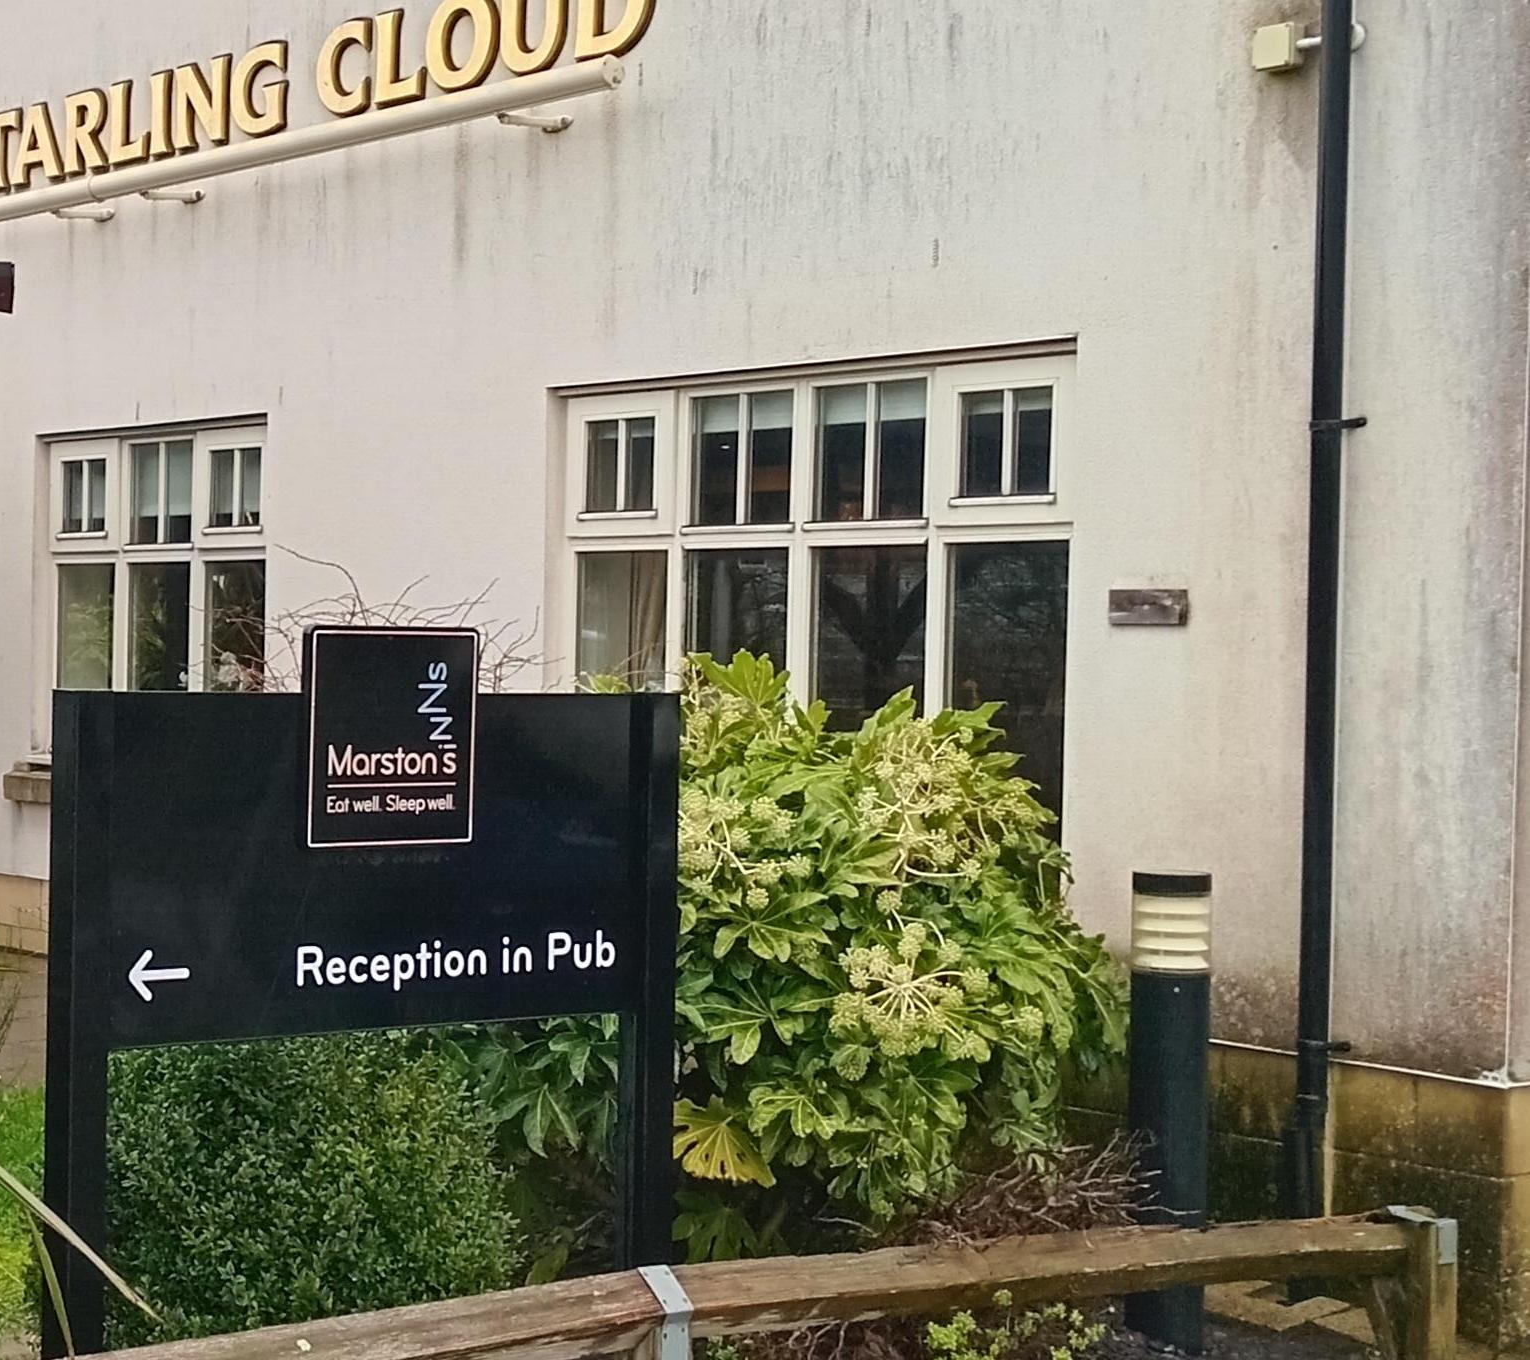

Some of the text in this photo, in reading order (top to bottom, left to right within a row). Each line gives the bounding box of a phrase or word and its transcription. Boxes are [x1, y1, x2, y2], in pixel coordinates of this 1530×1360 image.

[326, 796, 350, 813] Eat
[385, 794, 426, 815] Sleep
[296, 929, 616, 992] Reception in Pub
